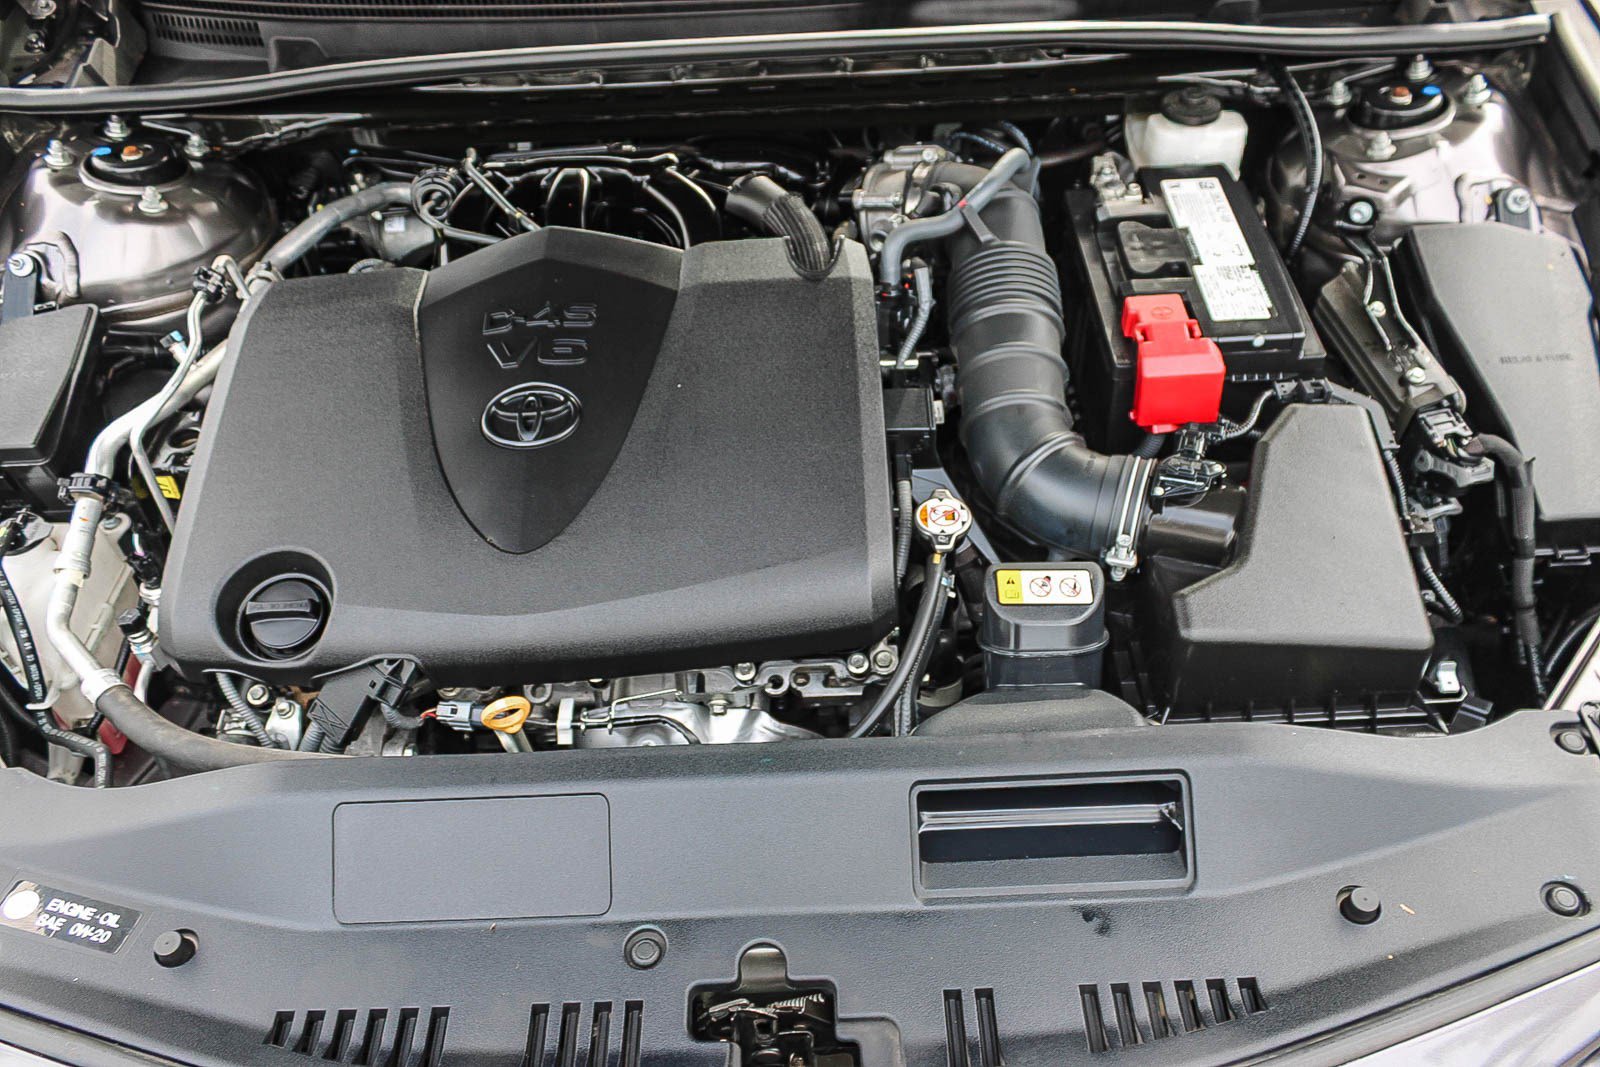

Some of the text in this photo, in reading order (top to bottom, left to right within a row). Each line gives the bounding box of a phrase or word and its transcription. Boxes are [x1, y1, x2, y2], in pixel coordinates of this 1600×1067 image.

[483, 302, 597, 335] D-4S
[487, 337, 588, 368] V6
[35, 913, 112, 943] SAE 0W-20
[45, 898, 121, 929] ENGINE OIL
